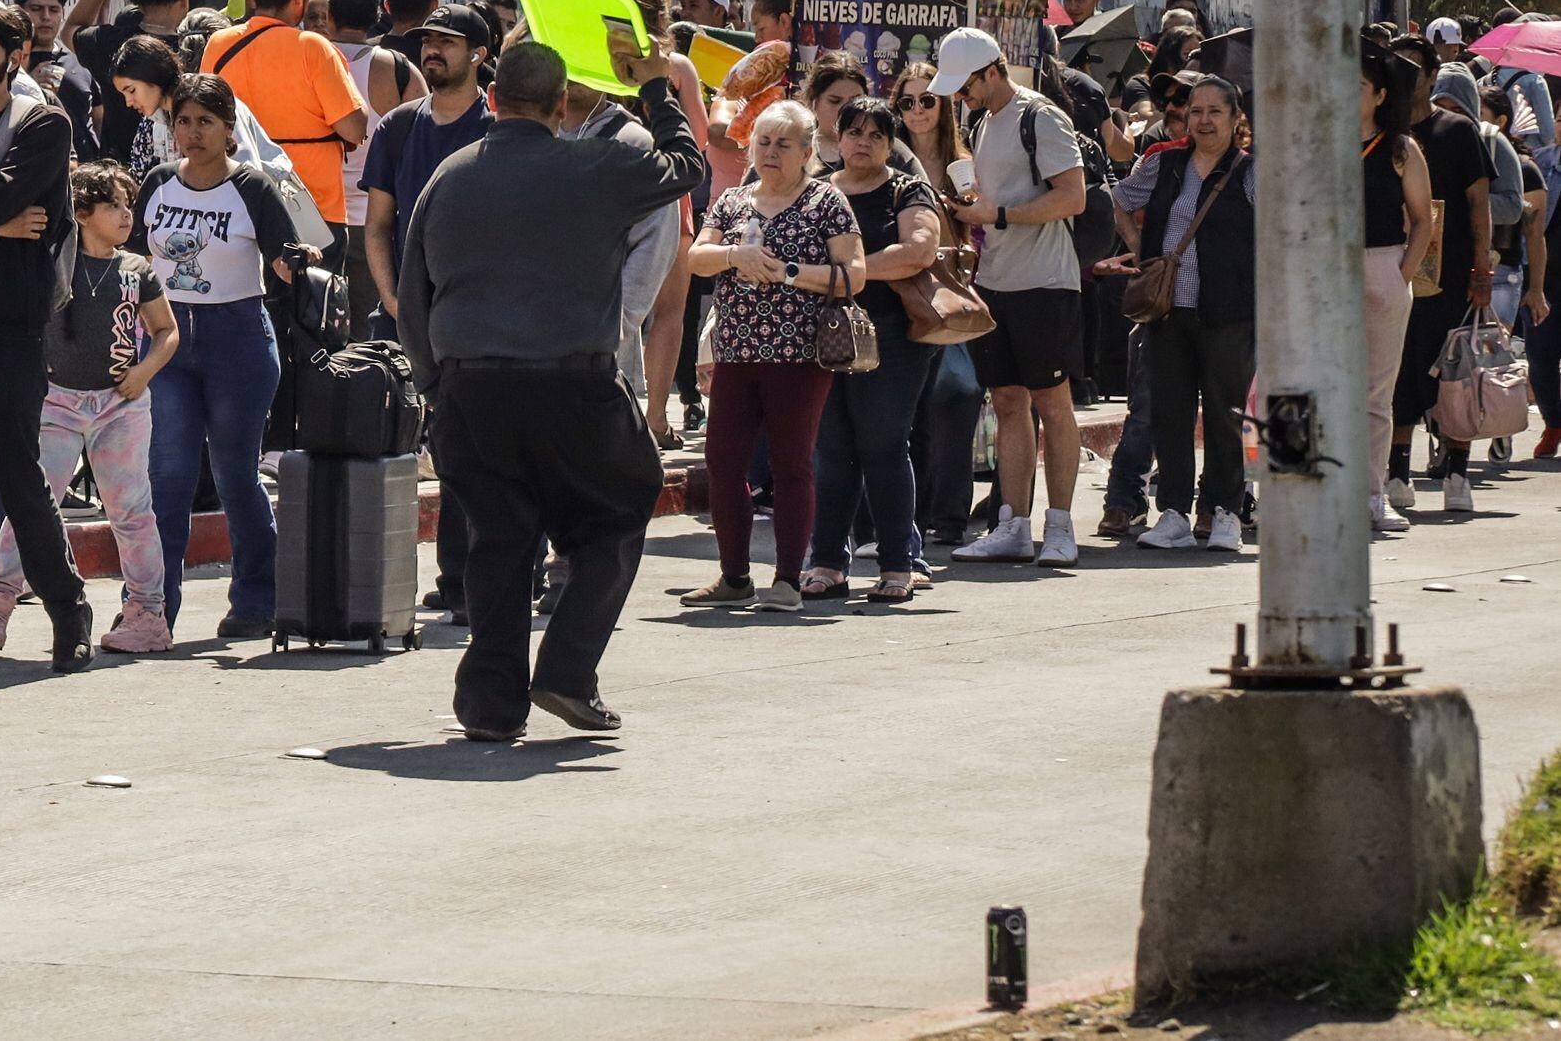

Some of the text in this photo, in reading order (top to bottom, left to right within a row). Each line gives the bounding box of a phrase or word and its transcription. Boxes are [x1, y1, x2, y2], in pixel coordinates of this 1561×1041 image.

[803, 0, 958, 27] NIEVES DE GARRAFA
[151, 203, 232, 243] STITCH
